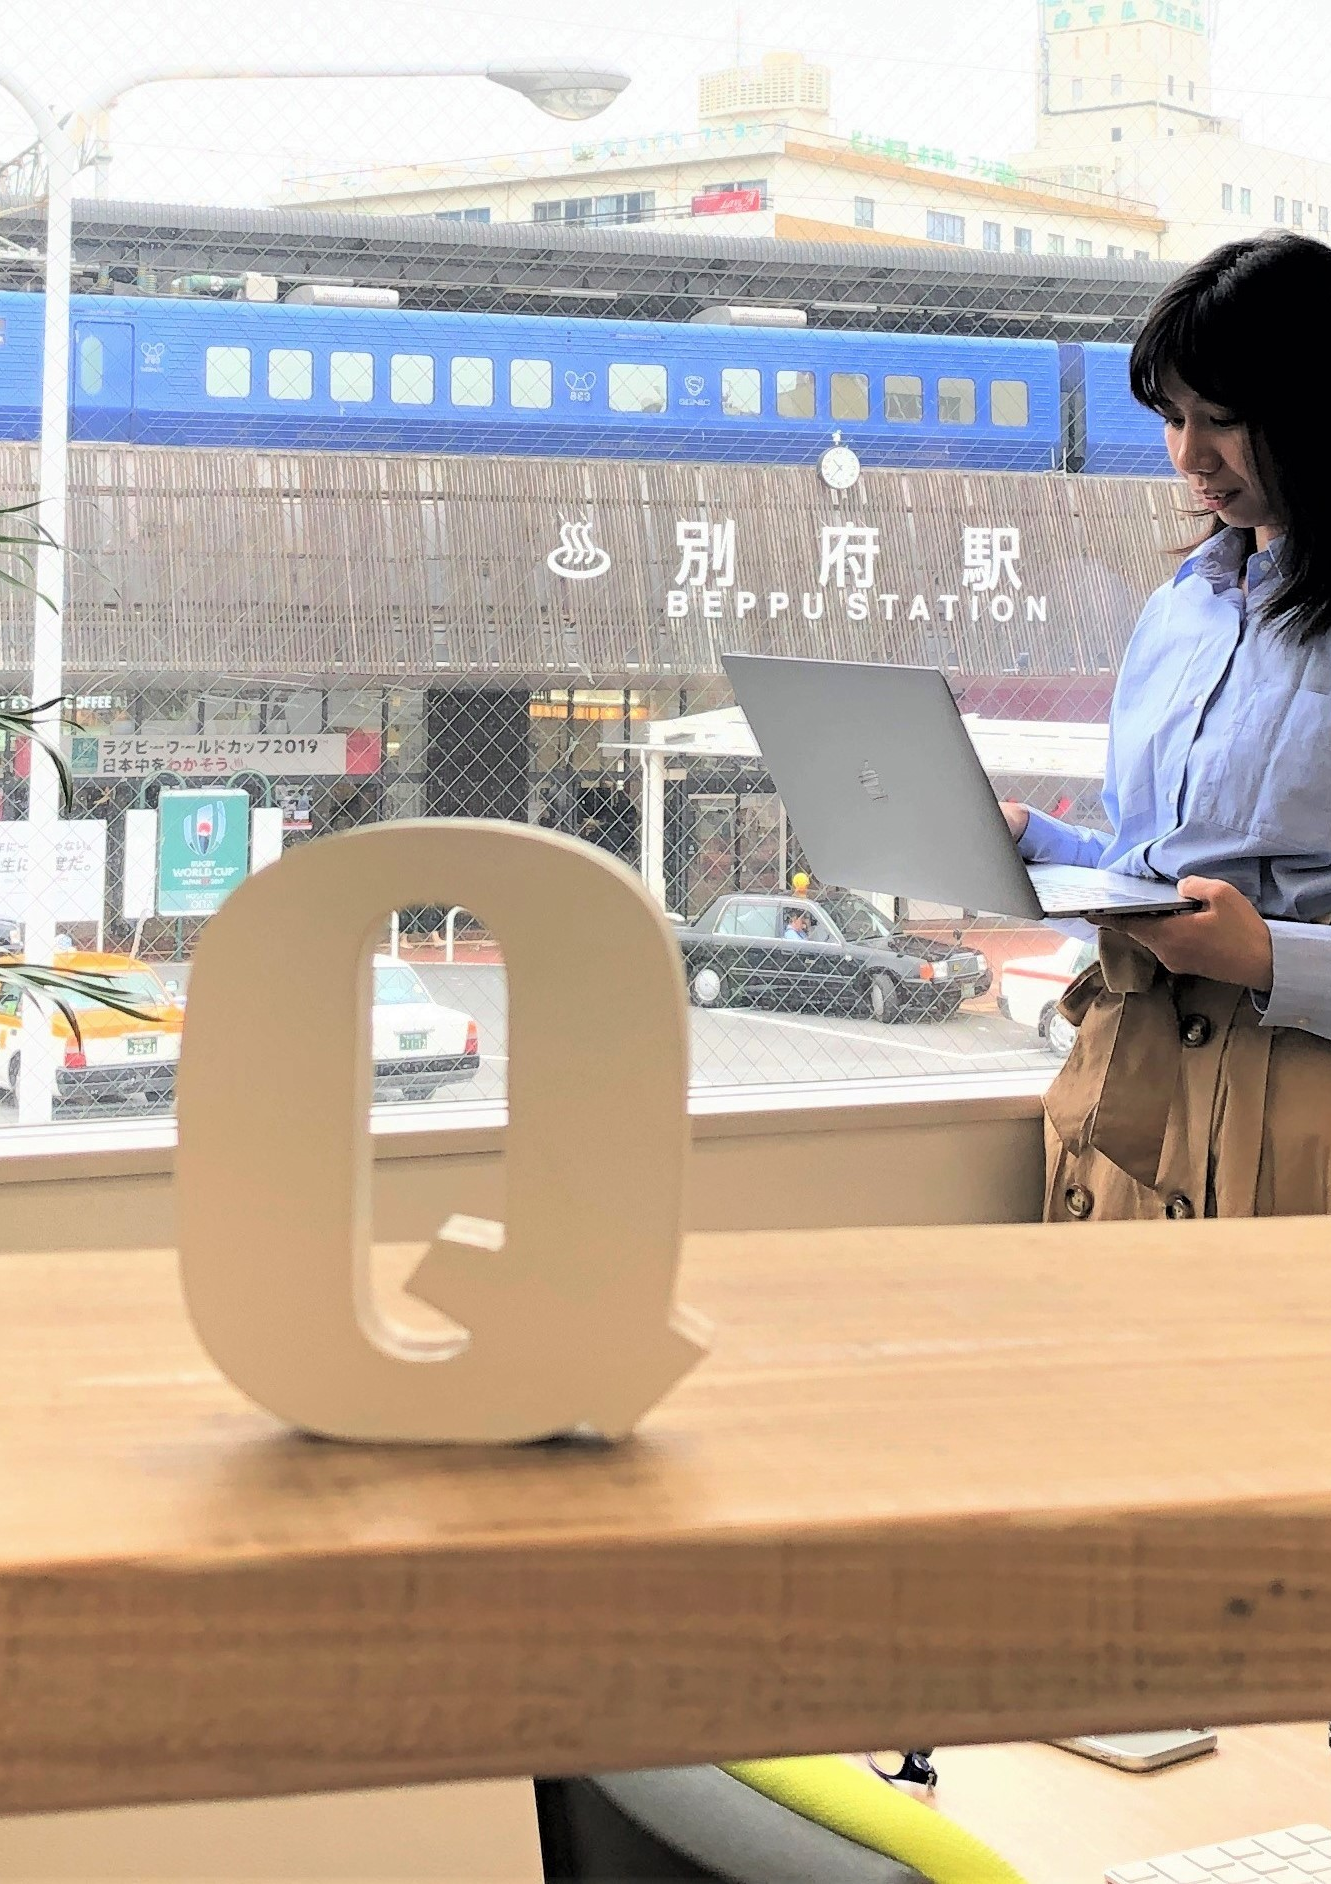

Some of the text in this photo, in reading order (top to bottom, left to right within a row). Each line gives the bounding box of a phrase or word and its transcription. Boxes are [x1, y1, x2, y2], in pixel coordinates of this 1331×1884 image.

[674, 518, 1022, 591] 別府駅
[668, 590, 1047, 622] BEPPU STATION
[172, 867, 212, 878] WORLD
[175, 817, 716, 1446] Q
